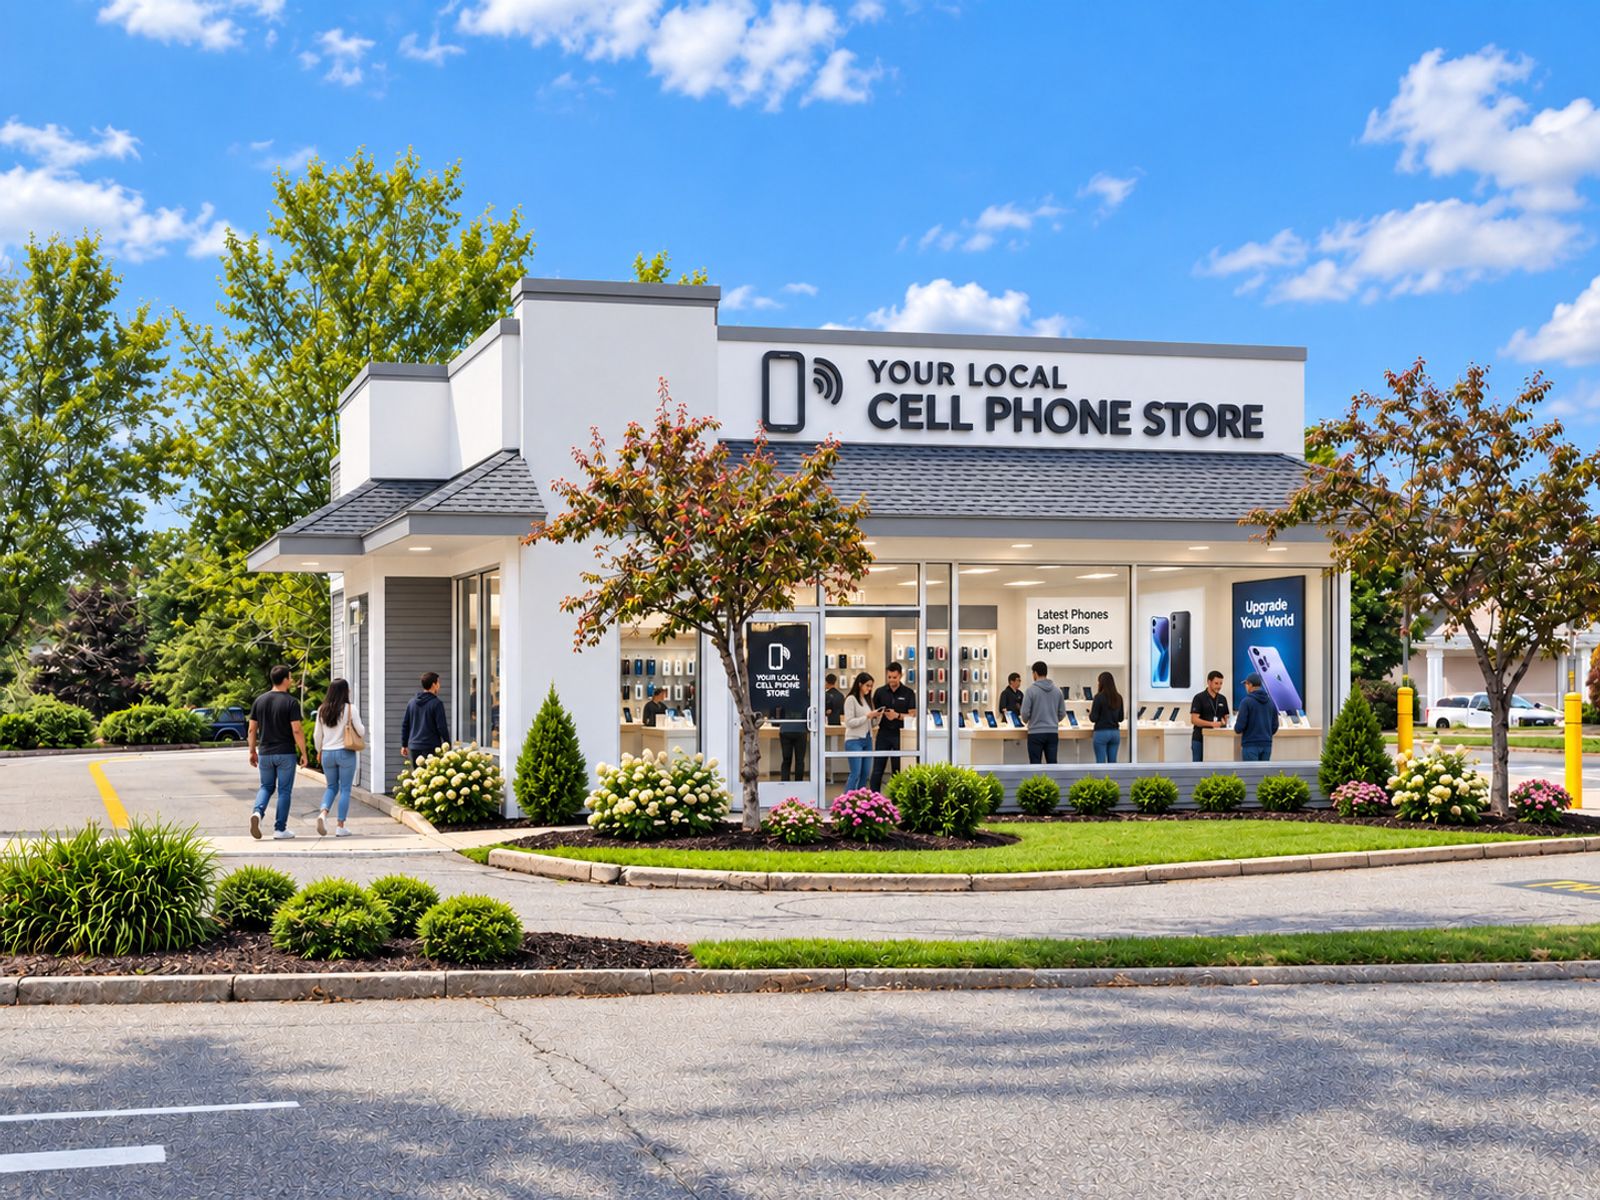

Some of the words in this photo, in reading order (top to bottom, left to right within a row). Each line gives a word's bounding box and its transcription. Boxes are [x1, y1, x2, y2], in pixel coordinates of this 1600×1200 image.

[867, 359, 955, 387] YOUR
[968, 362, 1068, 391] LOCAL
[867, 392, 974, 433] CELL
[985, 395, 1132, 437] PHONE
[1142, 400, 1265, 440] STORE
[1037, 608, 1069, 620] Latest
[1071, 608, 1109, 620] Phones
[1245, 597, 1288, 616] Upgrade
[1240, 616, 1263, 629] Your
[1264, 613, 1294, 628] World
[1037, 623, 1060, 635] Best
[1062, 623, 1090, 635] Plans
[1037, 638, 1070, 653] Expert
[1072, 638, 1113, 653] Support
[755, 681, 773, 689] CELL
[775, 681, 800, 689] PHONE
[766, 689, 790, 697] STORE
